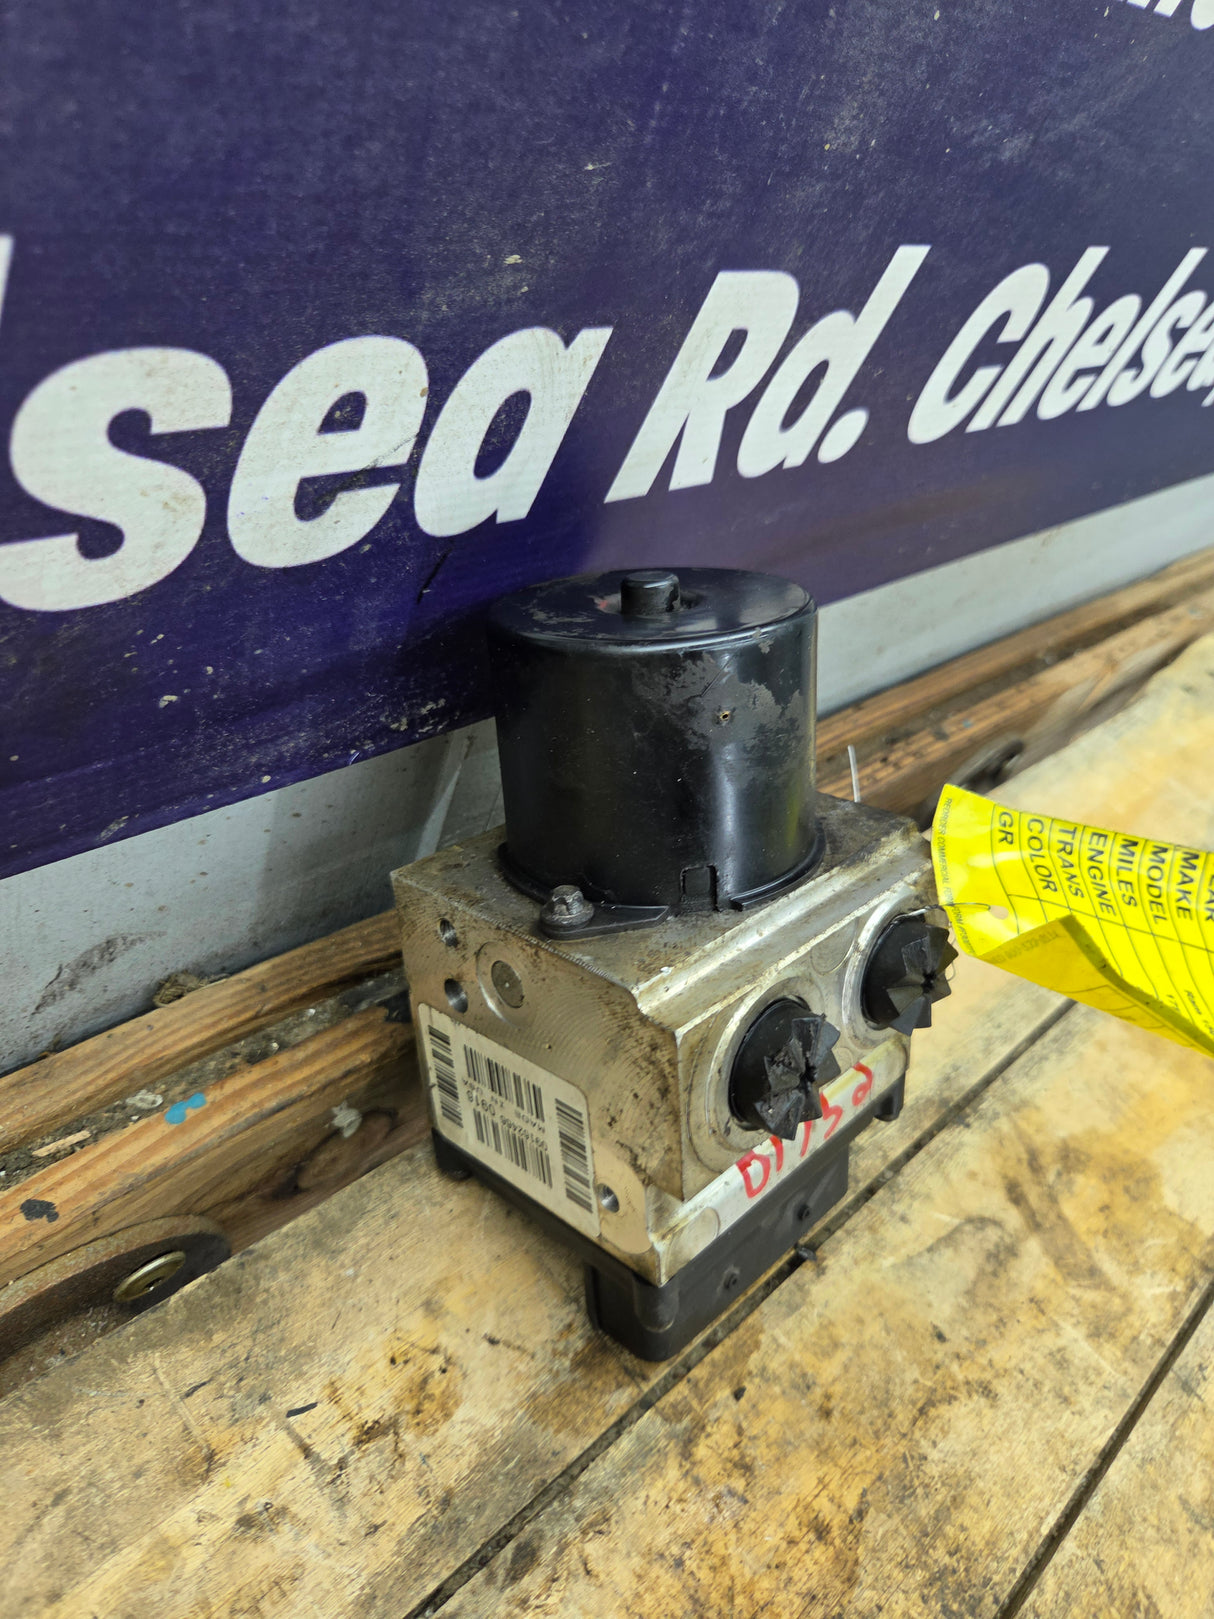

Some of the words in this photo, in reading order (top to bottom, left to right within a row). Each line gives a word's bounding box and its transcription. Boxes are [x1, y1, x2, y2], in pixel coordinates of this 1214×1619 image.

[0, 235, 614, 612] sea
[604, 245, 931, 504] Rd.
[998, 811, 1014, 846] GR
[1027, 818, 1058, 893] COLOR
[1056, 826, 1085, 898] TRANS
[1087, 832, 1116, 917] ENGINE
[1117, 838, 1138, 908] MILES
[1146, 844, 1169, 925] MODEL
[1175, 851, 1200, 921] MAKE
[515, 1109, 546, 1134] MADE
